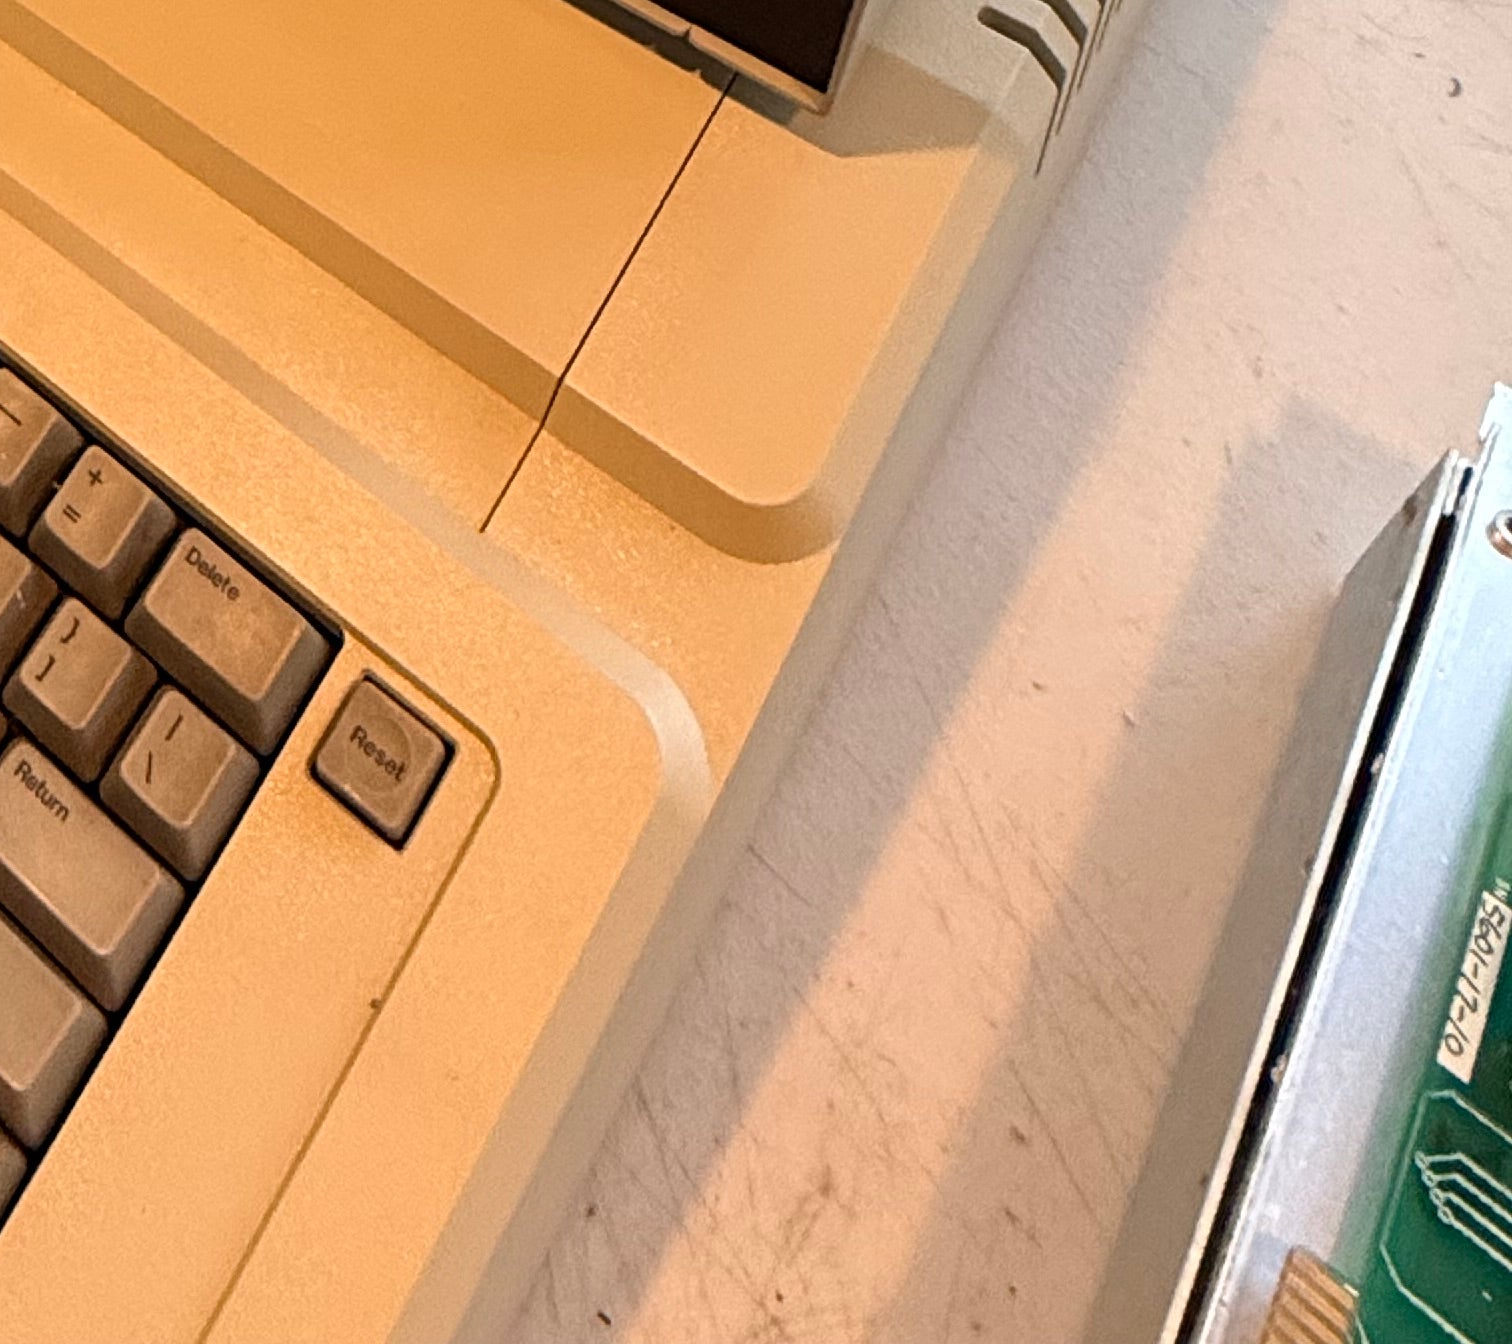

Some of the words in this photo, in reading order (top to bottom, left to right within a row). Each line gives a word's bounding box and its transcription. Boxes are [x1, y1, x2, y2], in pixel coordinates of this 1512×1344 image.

[88, 468, 104, 487] +
[62, 503, 82, 524] =
[184, 545, 241, 601] Delete
[349, 724, 410, 783] Reset
[13, 759, 70, 824] Return
